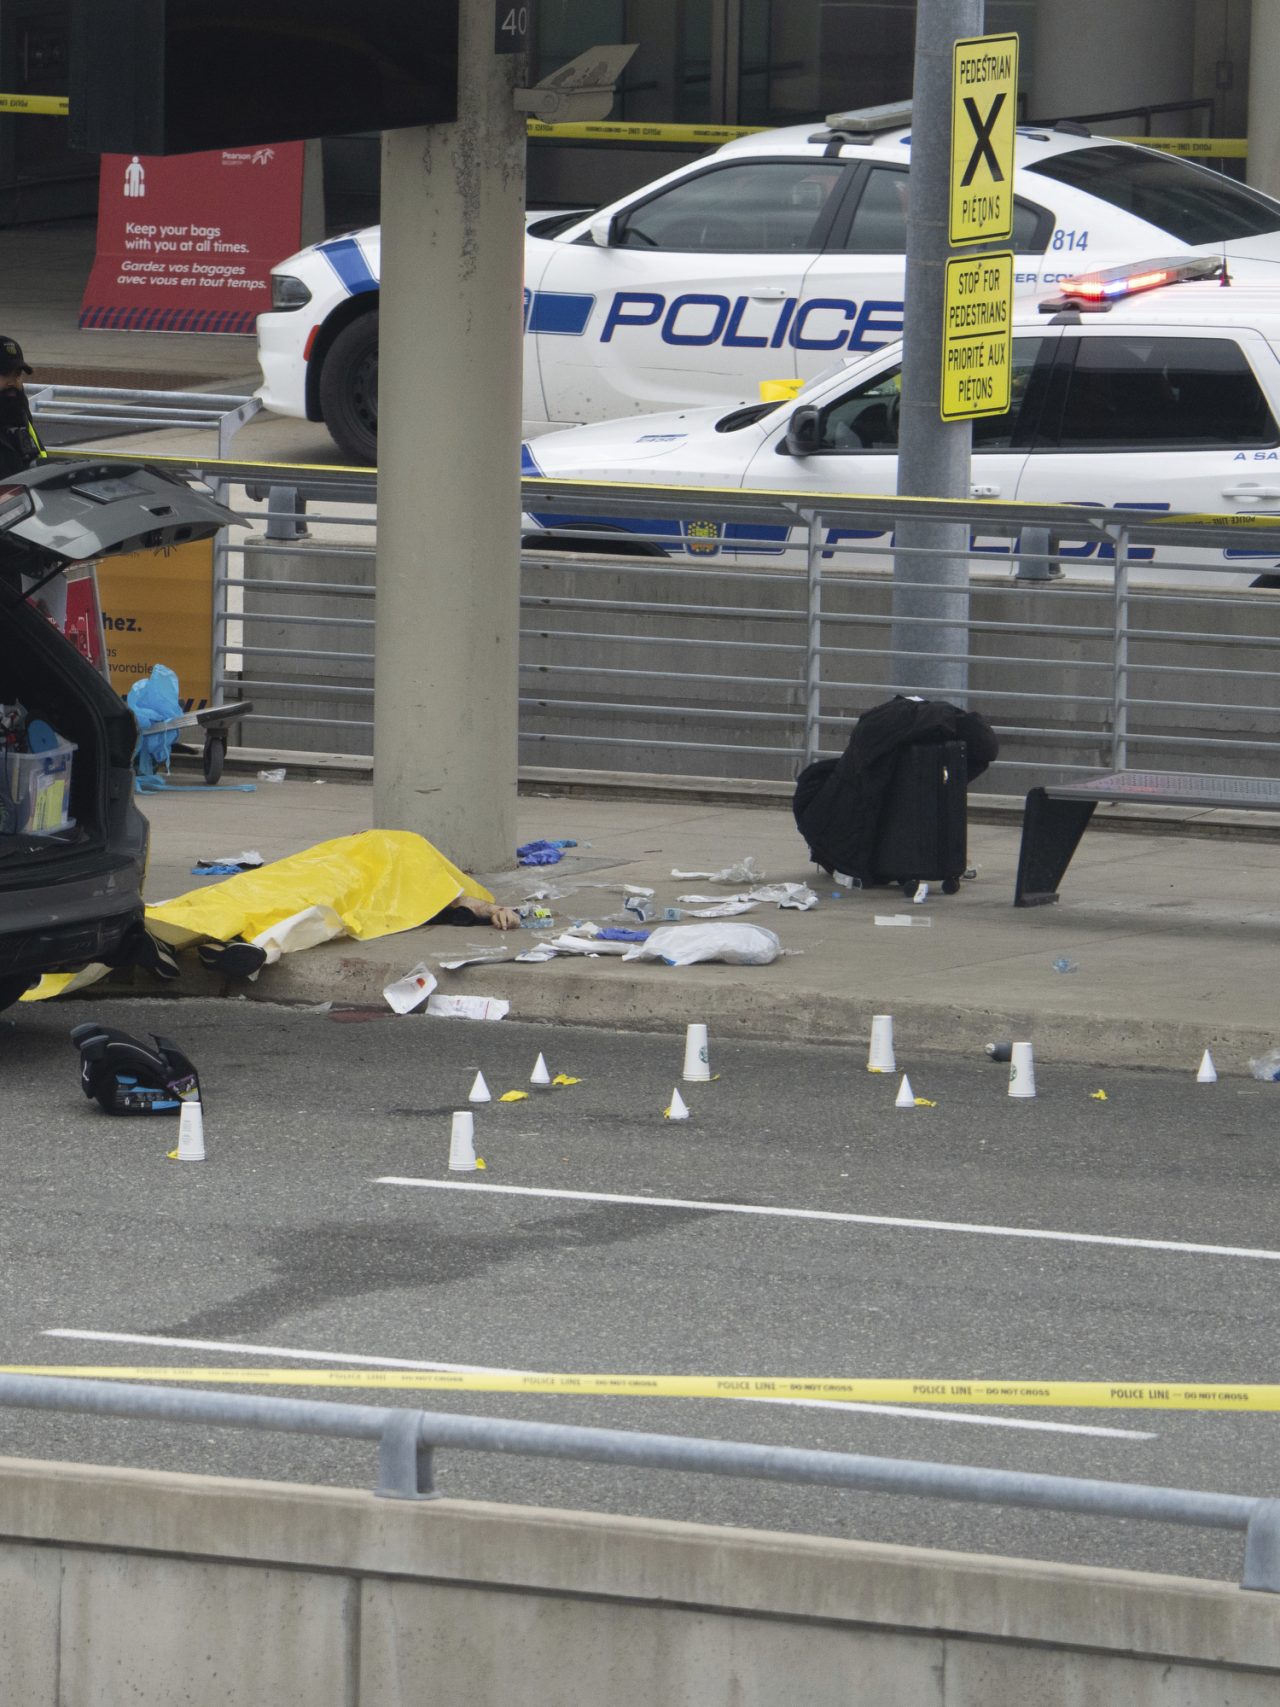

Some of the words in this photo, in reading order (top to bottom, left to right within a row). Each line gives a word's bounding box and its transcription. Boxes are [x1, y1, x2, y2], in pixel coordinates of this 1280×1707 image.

[501, 8, 527, 35] 40
[960, 55, 1011, 84] PEDESTRIAN
[960, 93, 1007, 187] X
[222, 152, 251, 160] Pearson
[962, 195, 1000, 224] PIÉTONS
[126, 222, 156, 237] Keep
[160, 225, 188, 238] your
[191, 224, 221, 239] bags
[1052, 229, 1088, 251] 814
[126, 237, 150, 250] with
[154, 240, 176, 253] you
[180, 240, 193, 251] at
[196, 241, 210, 252] all
[214, 240, 249, 253] times.
[121, 261, 165, 272] Gardez
[168, 264, 189, 273] vos
[192, 263, 246, 277] bagages
[117, 276, 146, 284] avec
[150, 277, 178, 286] vous
[200, 277, 224, 287] tout
[227, 278, 267, 290] temps.
[958, 271, 980, 295] STOP
[984, 268, 1000, 291] FOR
[600, 291, 904, 352] POLICE
[949, 300, 1006, 328] PEDESTRIANS
[948, 342, 984, 371] PRIORITÉ
[988, 343, 1006, 366] AUX
[958, 376, 993, 402] PIÉTONS
[1234, 452, 1246, 460] A
[718, 1381, 750, 1390] POLICE
[755, 1382, 776, 1390] LINE
[913, 1385, 946, 1394] POLICE
[951, 1386, 972, 1395] LINE
[1110, 1388, 1144, 1399] POLICE
[1149, 1390, 1170, 1400] LINE
